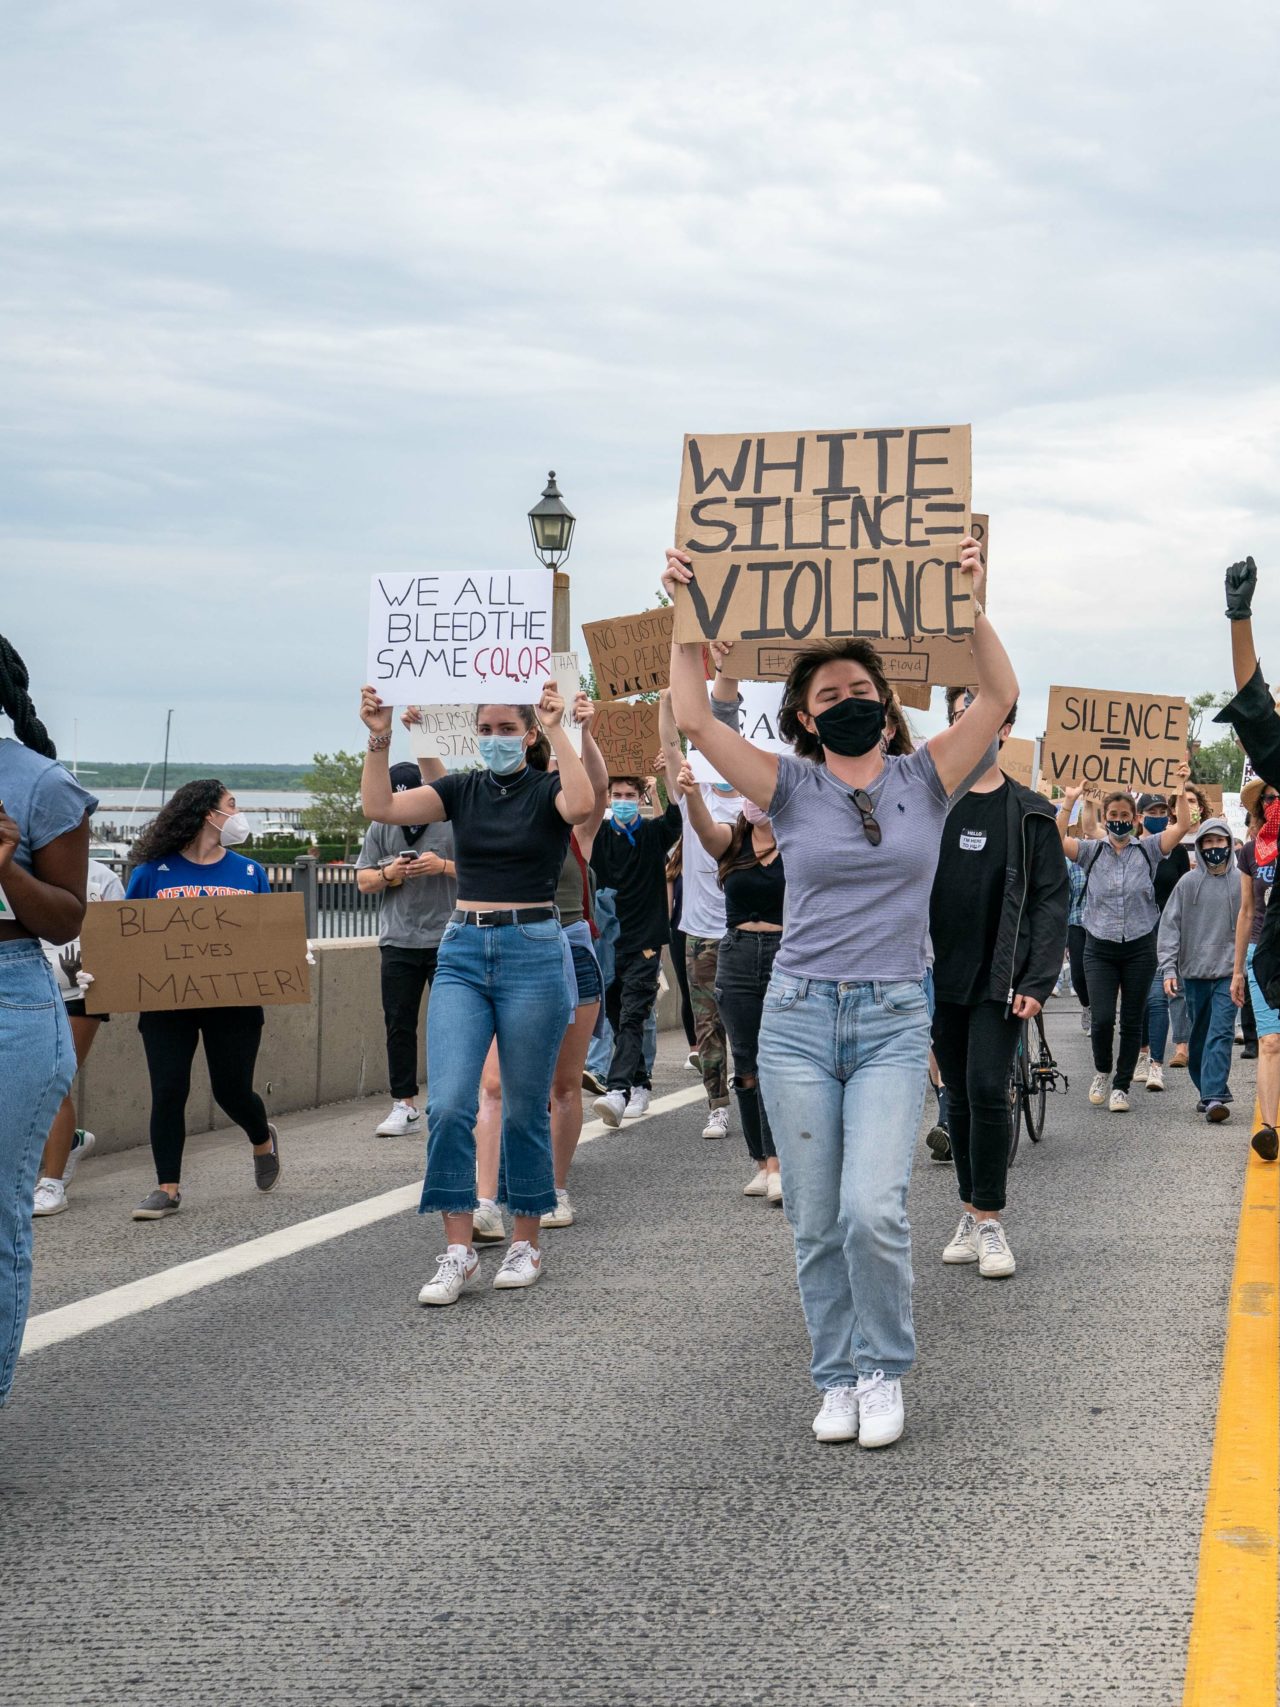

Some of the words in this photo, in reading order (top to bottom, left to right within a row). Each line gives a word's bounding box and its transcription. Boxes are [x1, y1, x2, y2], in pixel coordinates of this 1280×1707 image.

[688, 428, 954, 495] WHITE
[378, 577, 440, 606] WE
[454, 575, 525, 606] ALL
[684, 557, 975, 640] VIOLENCE
[592, 627, 617, 655] NO
[621, 614, 674, 647] JUSTIC
[377, 647, 467, 680] SAME
[474, 646, 551, 681] COLOR
[599, 655, 630, 682] NO
[609, 675, 643, 697] BLACK
[591, 709, 655, 740] ACK
[1061, 696, 1183, 741] SILENCE
[1051, 752, 1181, 788] VIOLENCE
[117, 905, 242, 937] BLACK
[164, 942, 233, 961] LIVES
[138, 966, 306, 1004] MATTER!
